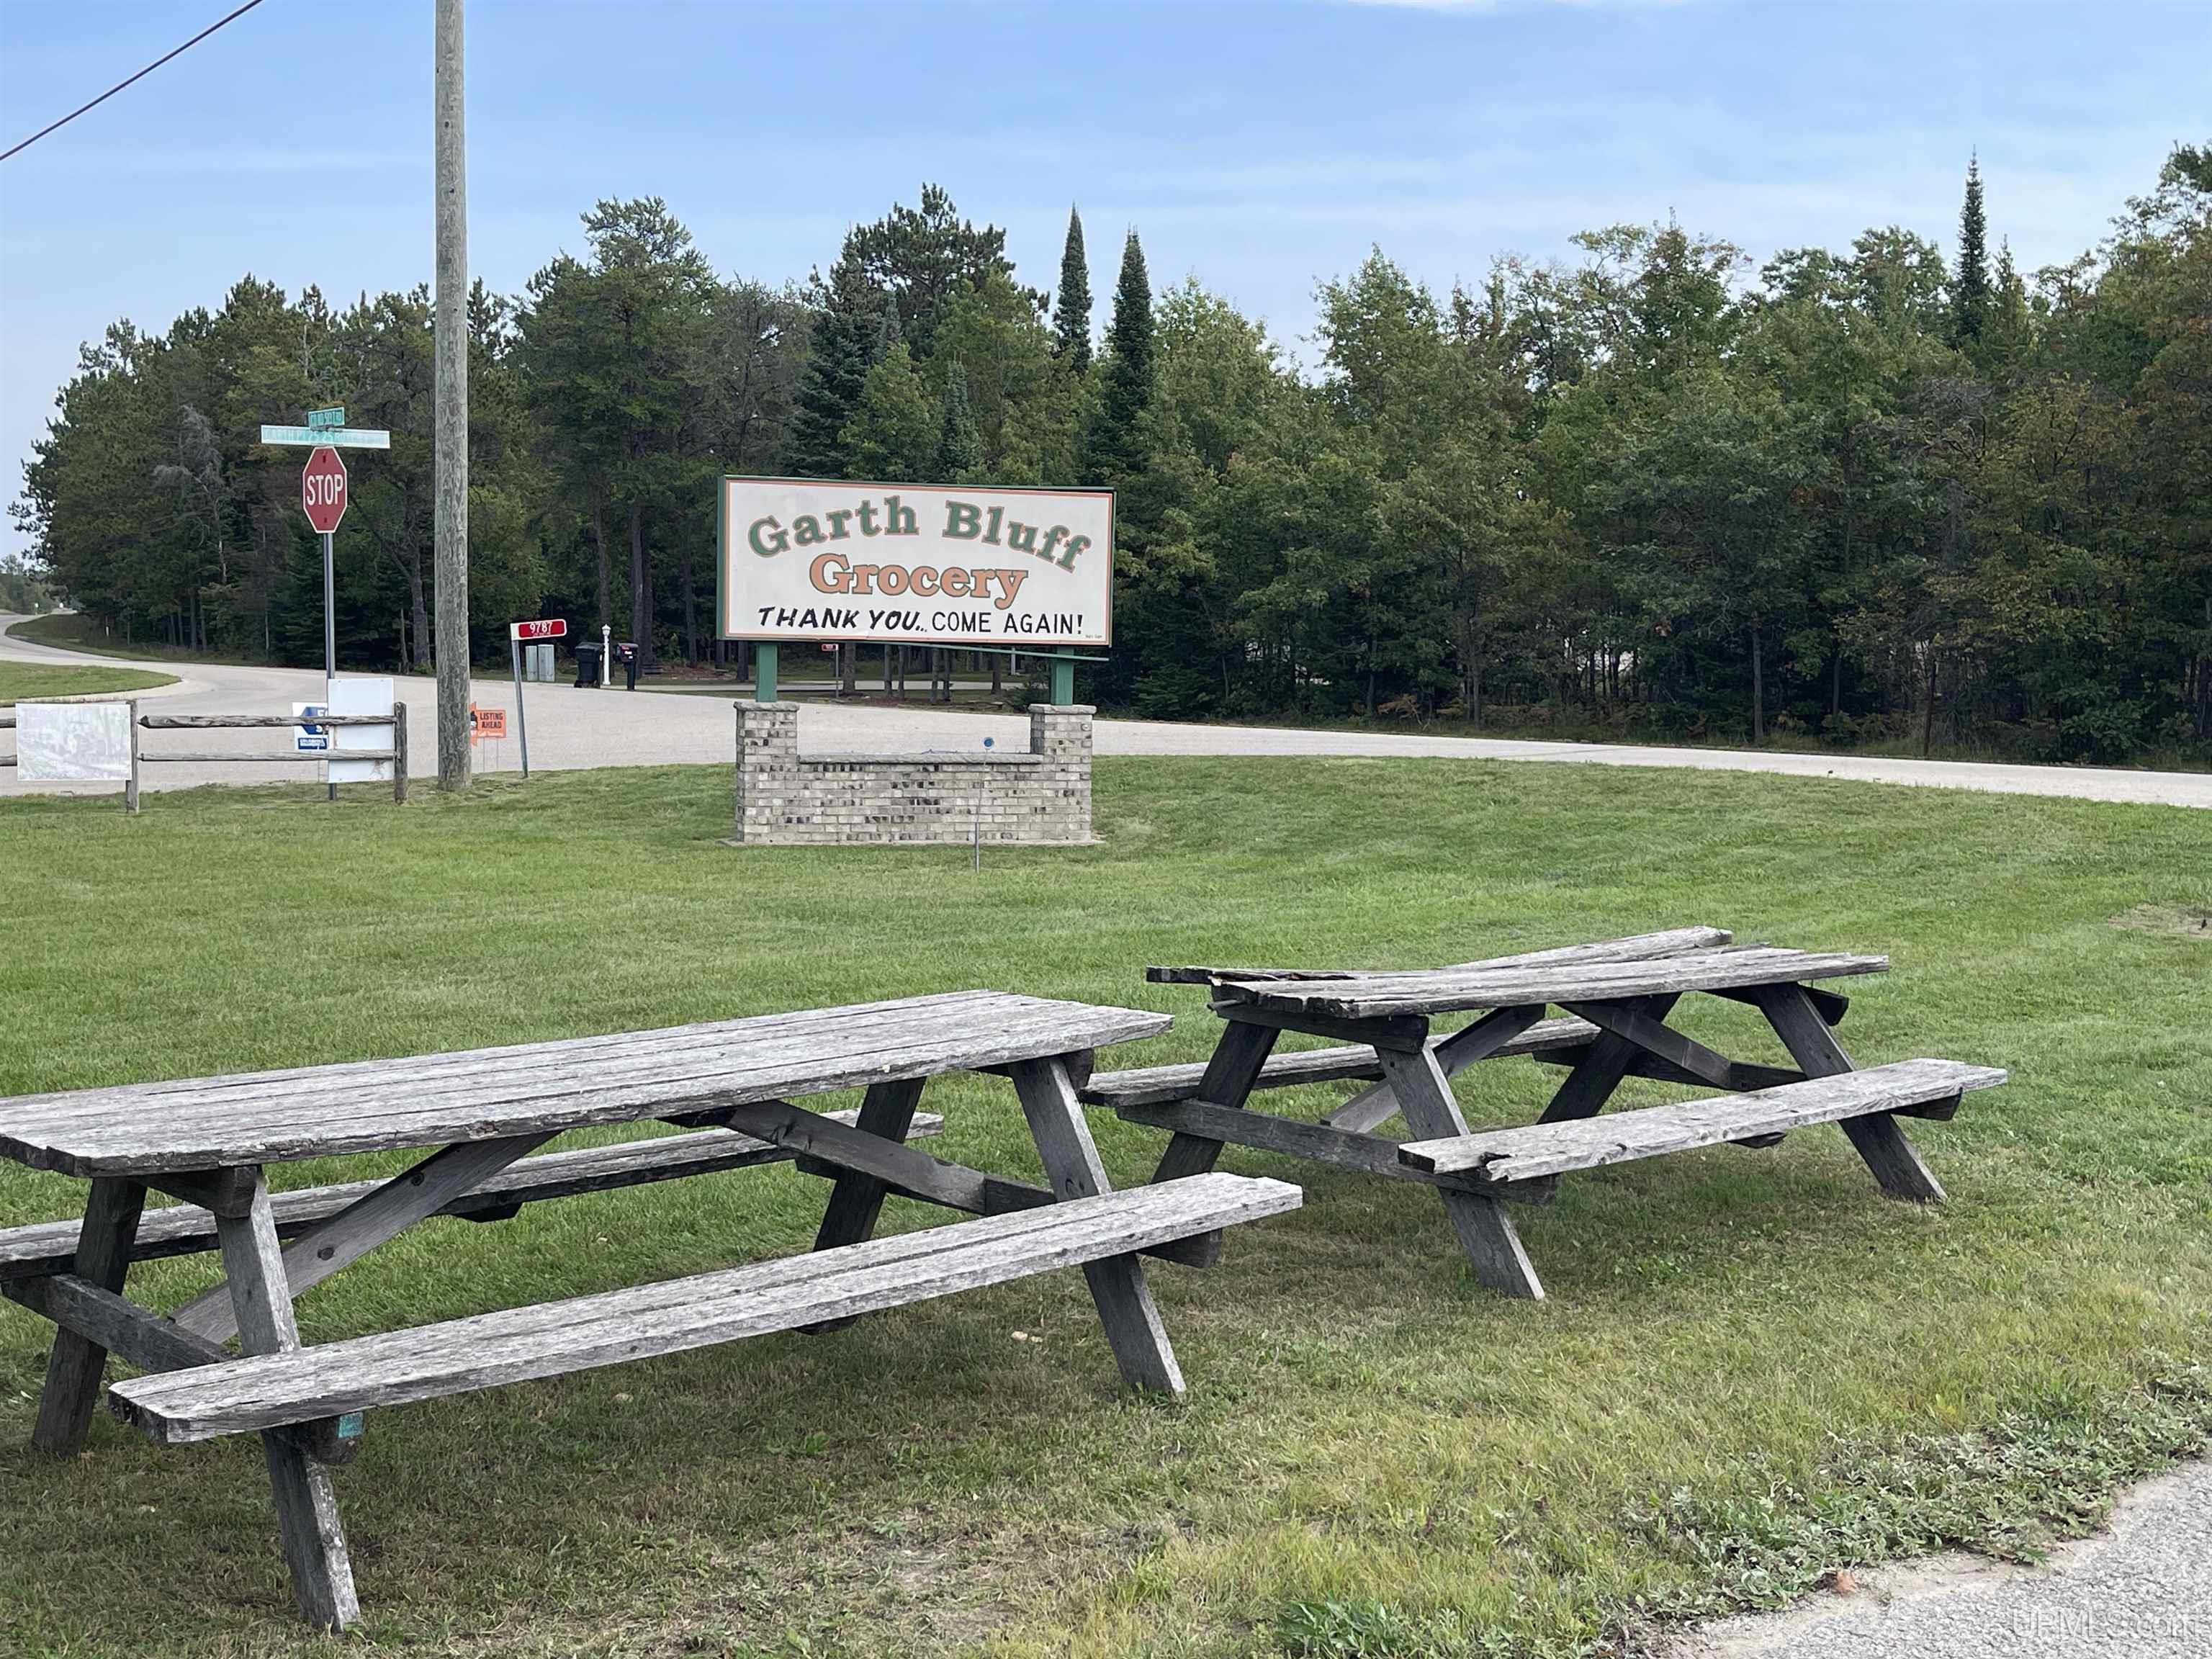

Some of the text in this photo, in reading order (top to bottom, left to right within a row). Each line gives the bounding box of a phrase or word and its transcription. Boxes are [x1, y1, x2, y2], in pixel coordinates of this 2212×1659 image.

[306, 474, 343, 506] STOP
[747, 495, 1092, 575] Garth Bluff
[809, 552, 1029, 610] Grocery
[529, 621, 553, 634] 9787
[757, 606, 860, 629] THANK
[932, 611, 992, 633] COME
[1003, 613, 1084, 634] AGAIN!
[480, 712, 503, 721] LISTING
[481, 720, 502, 729] AHEAD
